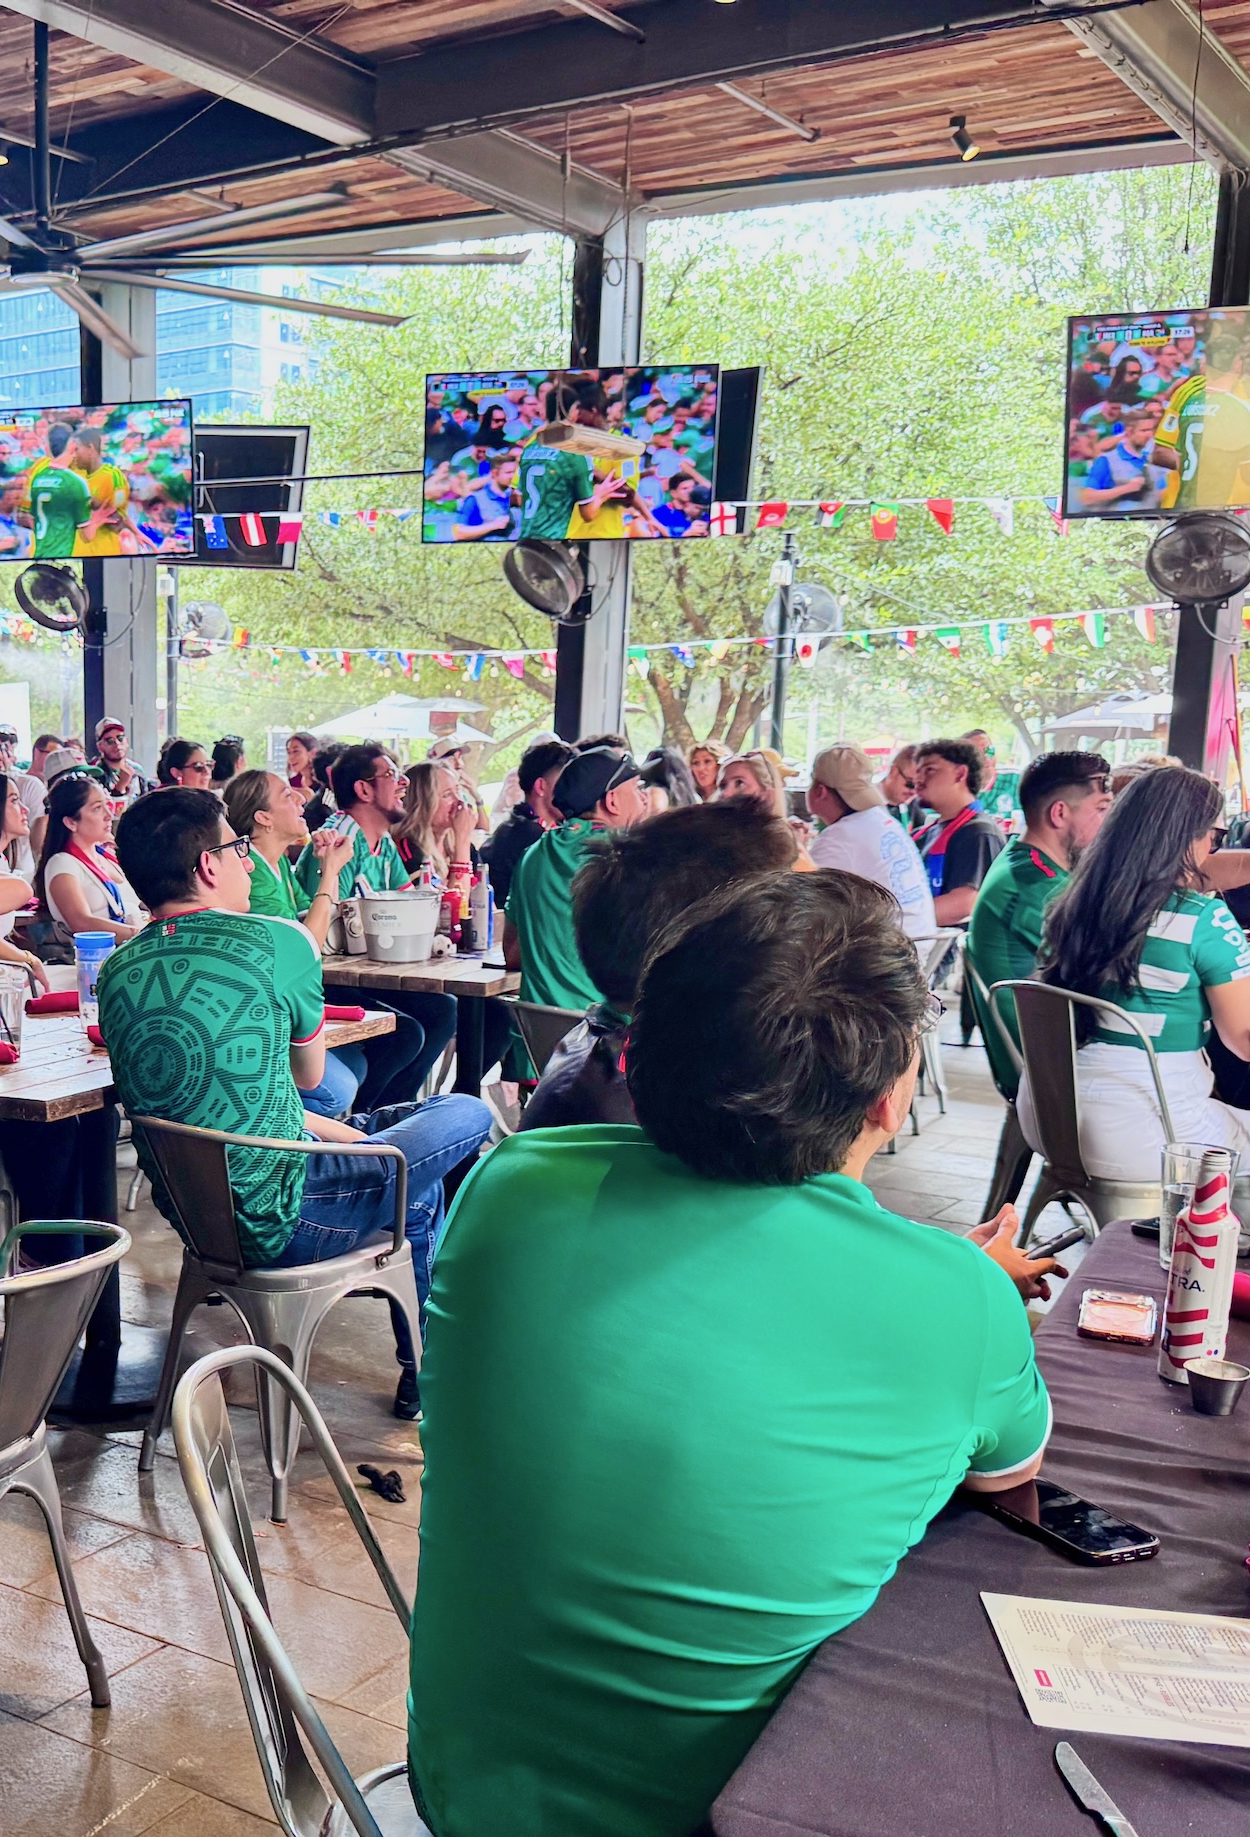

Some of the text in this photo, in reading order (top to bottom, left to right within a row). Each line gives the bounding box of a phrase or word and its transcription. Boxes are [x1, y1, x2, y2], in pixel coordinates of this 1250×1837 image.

[1182, 423, 1205, 481] 5
[524, 465, 546, 519] 5
[371, 913, 398, 921] Corona
[1171, 1272, 1205, 1292] TRA.
